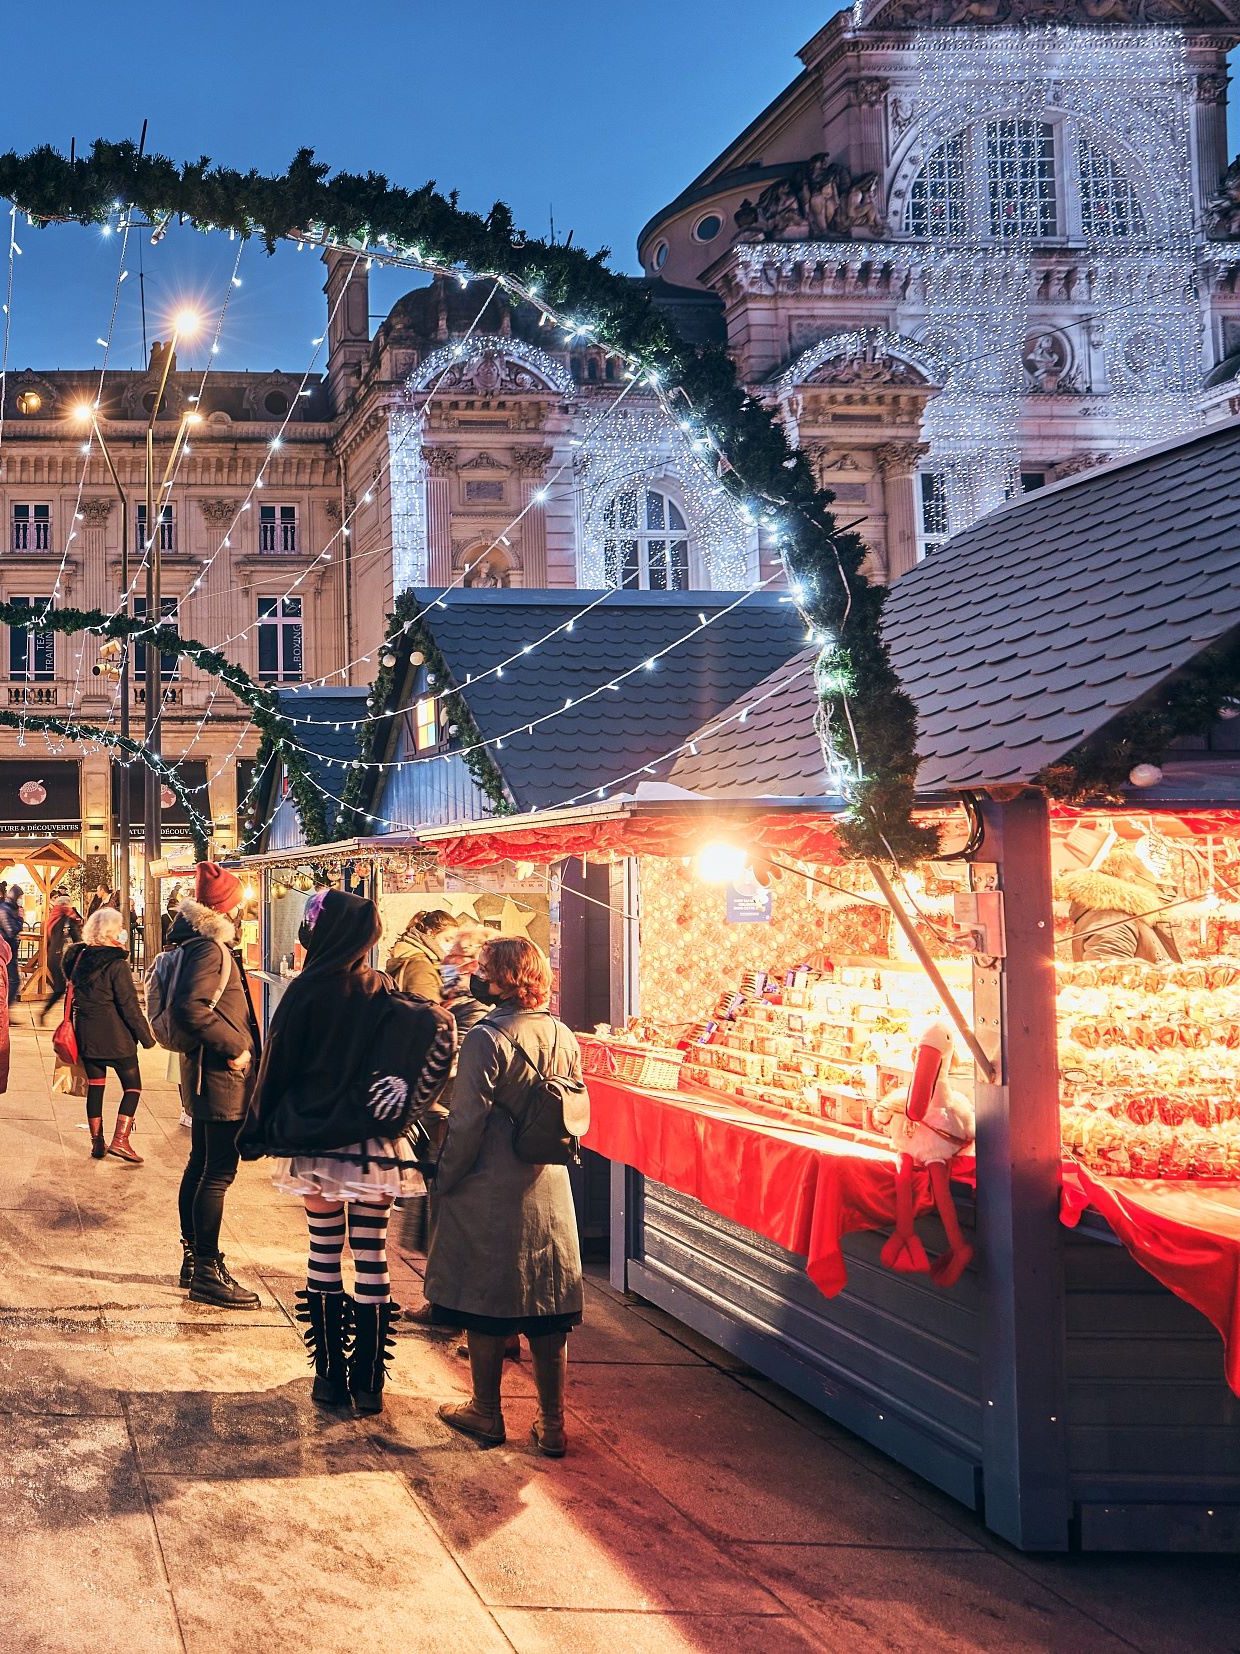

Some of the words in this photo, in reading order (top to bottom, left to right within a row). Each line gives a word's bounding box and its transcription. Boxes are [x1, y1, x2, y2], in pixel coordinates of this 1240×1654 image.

[37, 630, 45, 651] TEA
[45, 630, 54, 671] TRAININ
[293, 624, 302, 662] BOXING
[27, 823, 79, 831] DÉCOUVERTES
